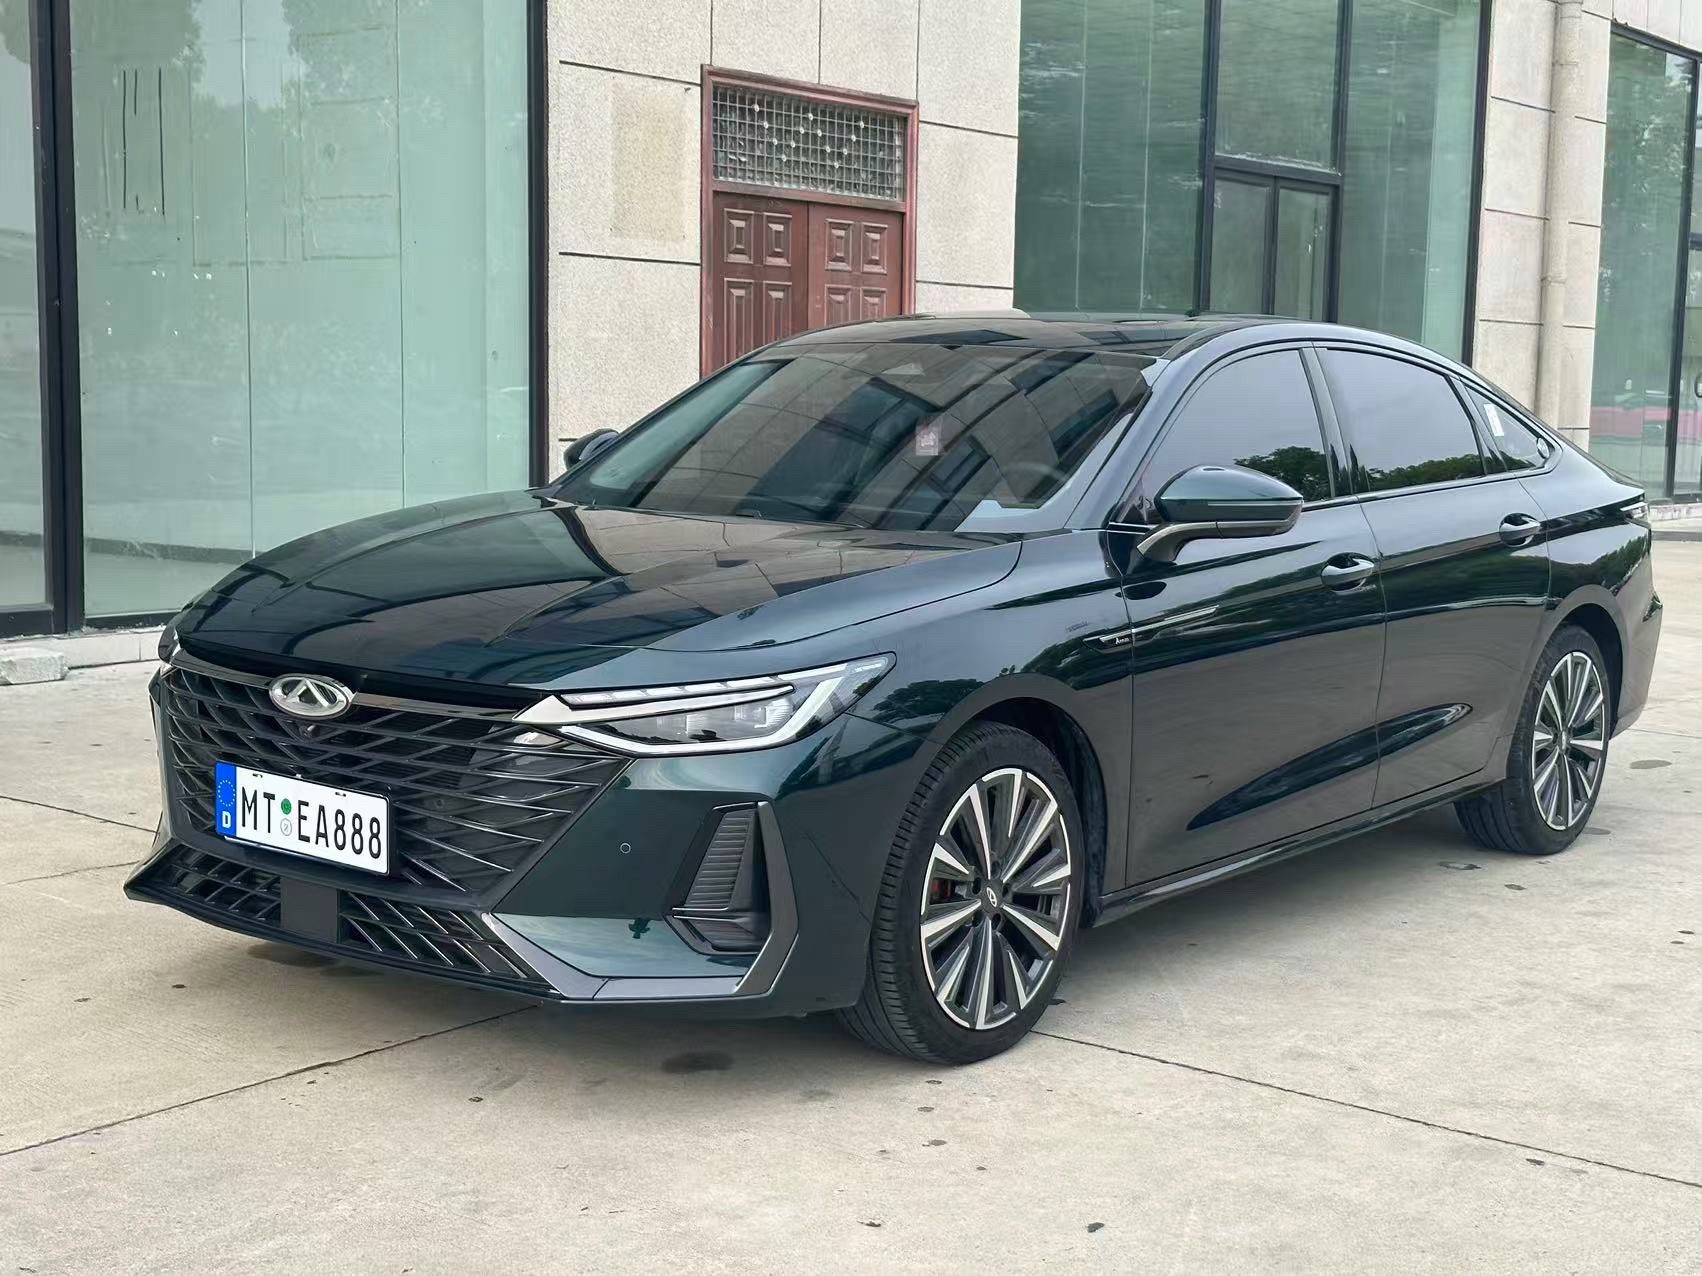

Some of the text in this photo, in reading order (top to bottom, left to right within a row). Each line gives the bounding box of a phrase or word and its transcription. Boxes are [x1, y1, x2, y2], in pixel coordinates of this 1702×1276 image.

[221, 810, 232, 829] D
[241, 786, 382, 859] MT EA888
